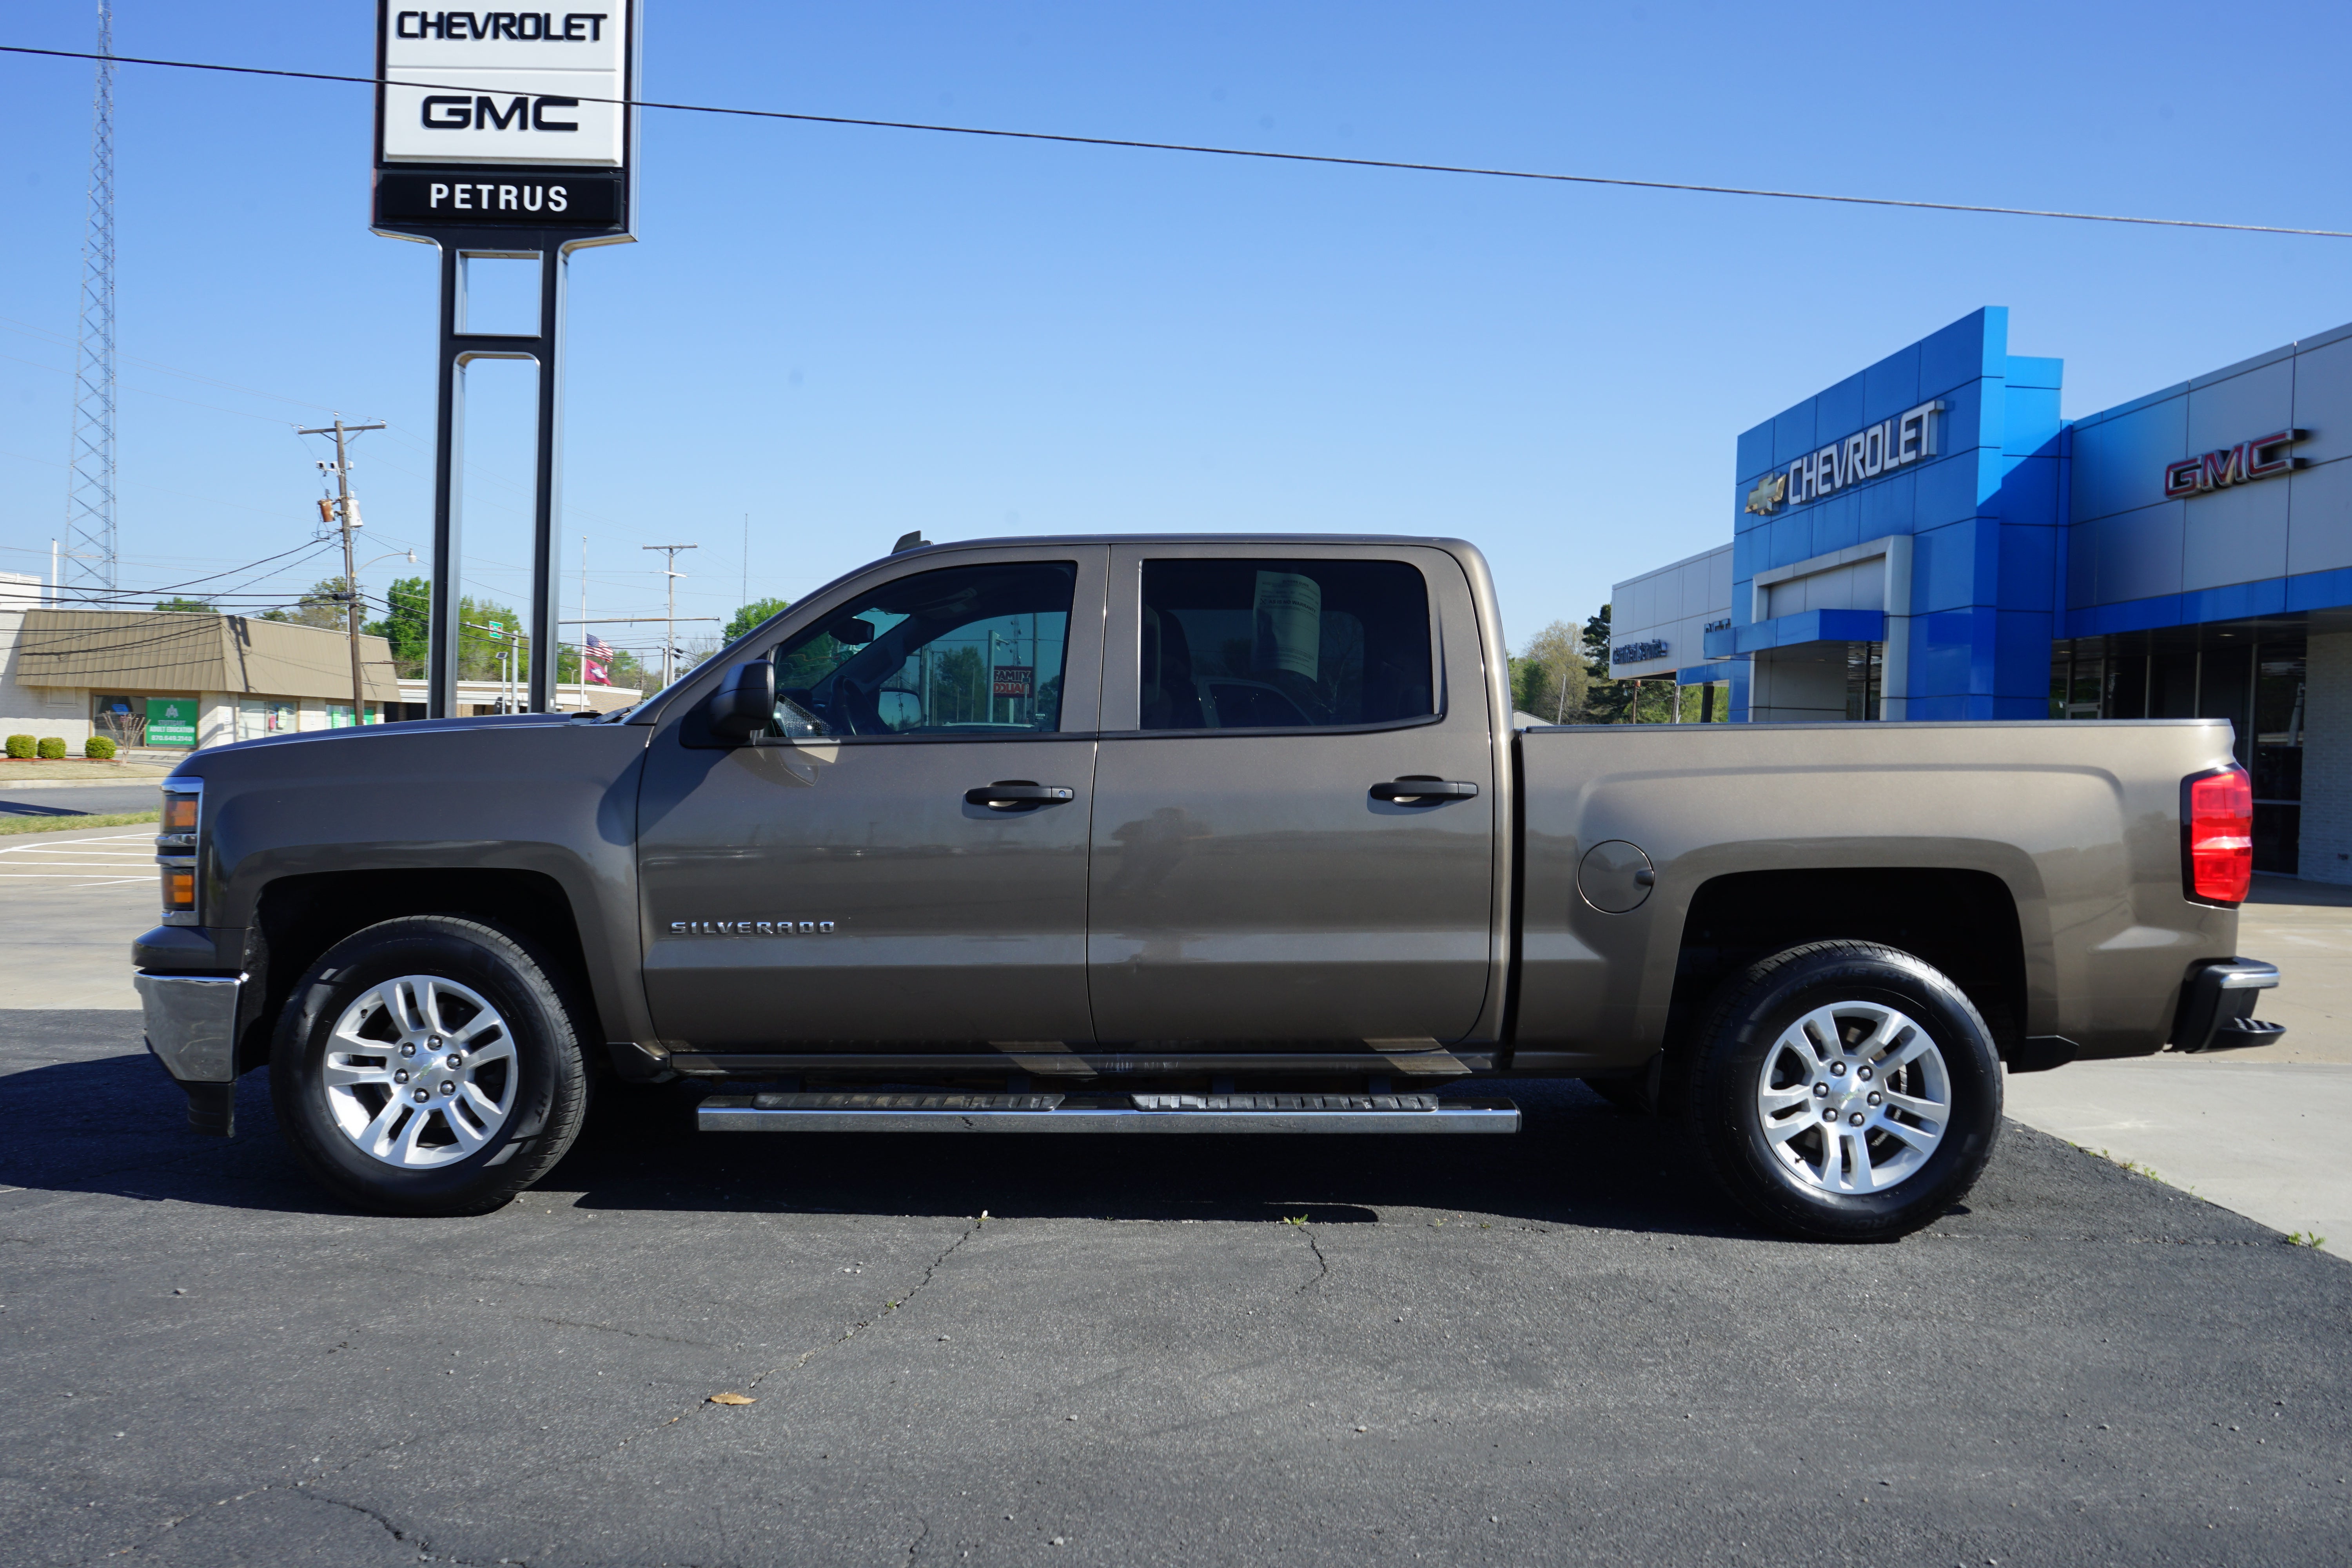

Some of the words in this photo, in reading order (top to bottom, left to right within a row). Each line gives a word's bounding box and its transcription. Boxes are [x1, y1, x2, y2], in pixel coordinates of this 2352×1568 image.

[397, 11, 608, 41] CHEVROLET
[423, 95, 579, 131] GMC
[430, 183, 568, 212] PETRUS
[1788, 400, 1940, 505] CHEVROLET
[2165, 428, 2301, 499] GMC
[993, 670, 1031, 681] FAMILY
[671, 922, 834, 934] SILVERADO
